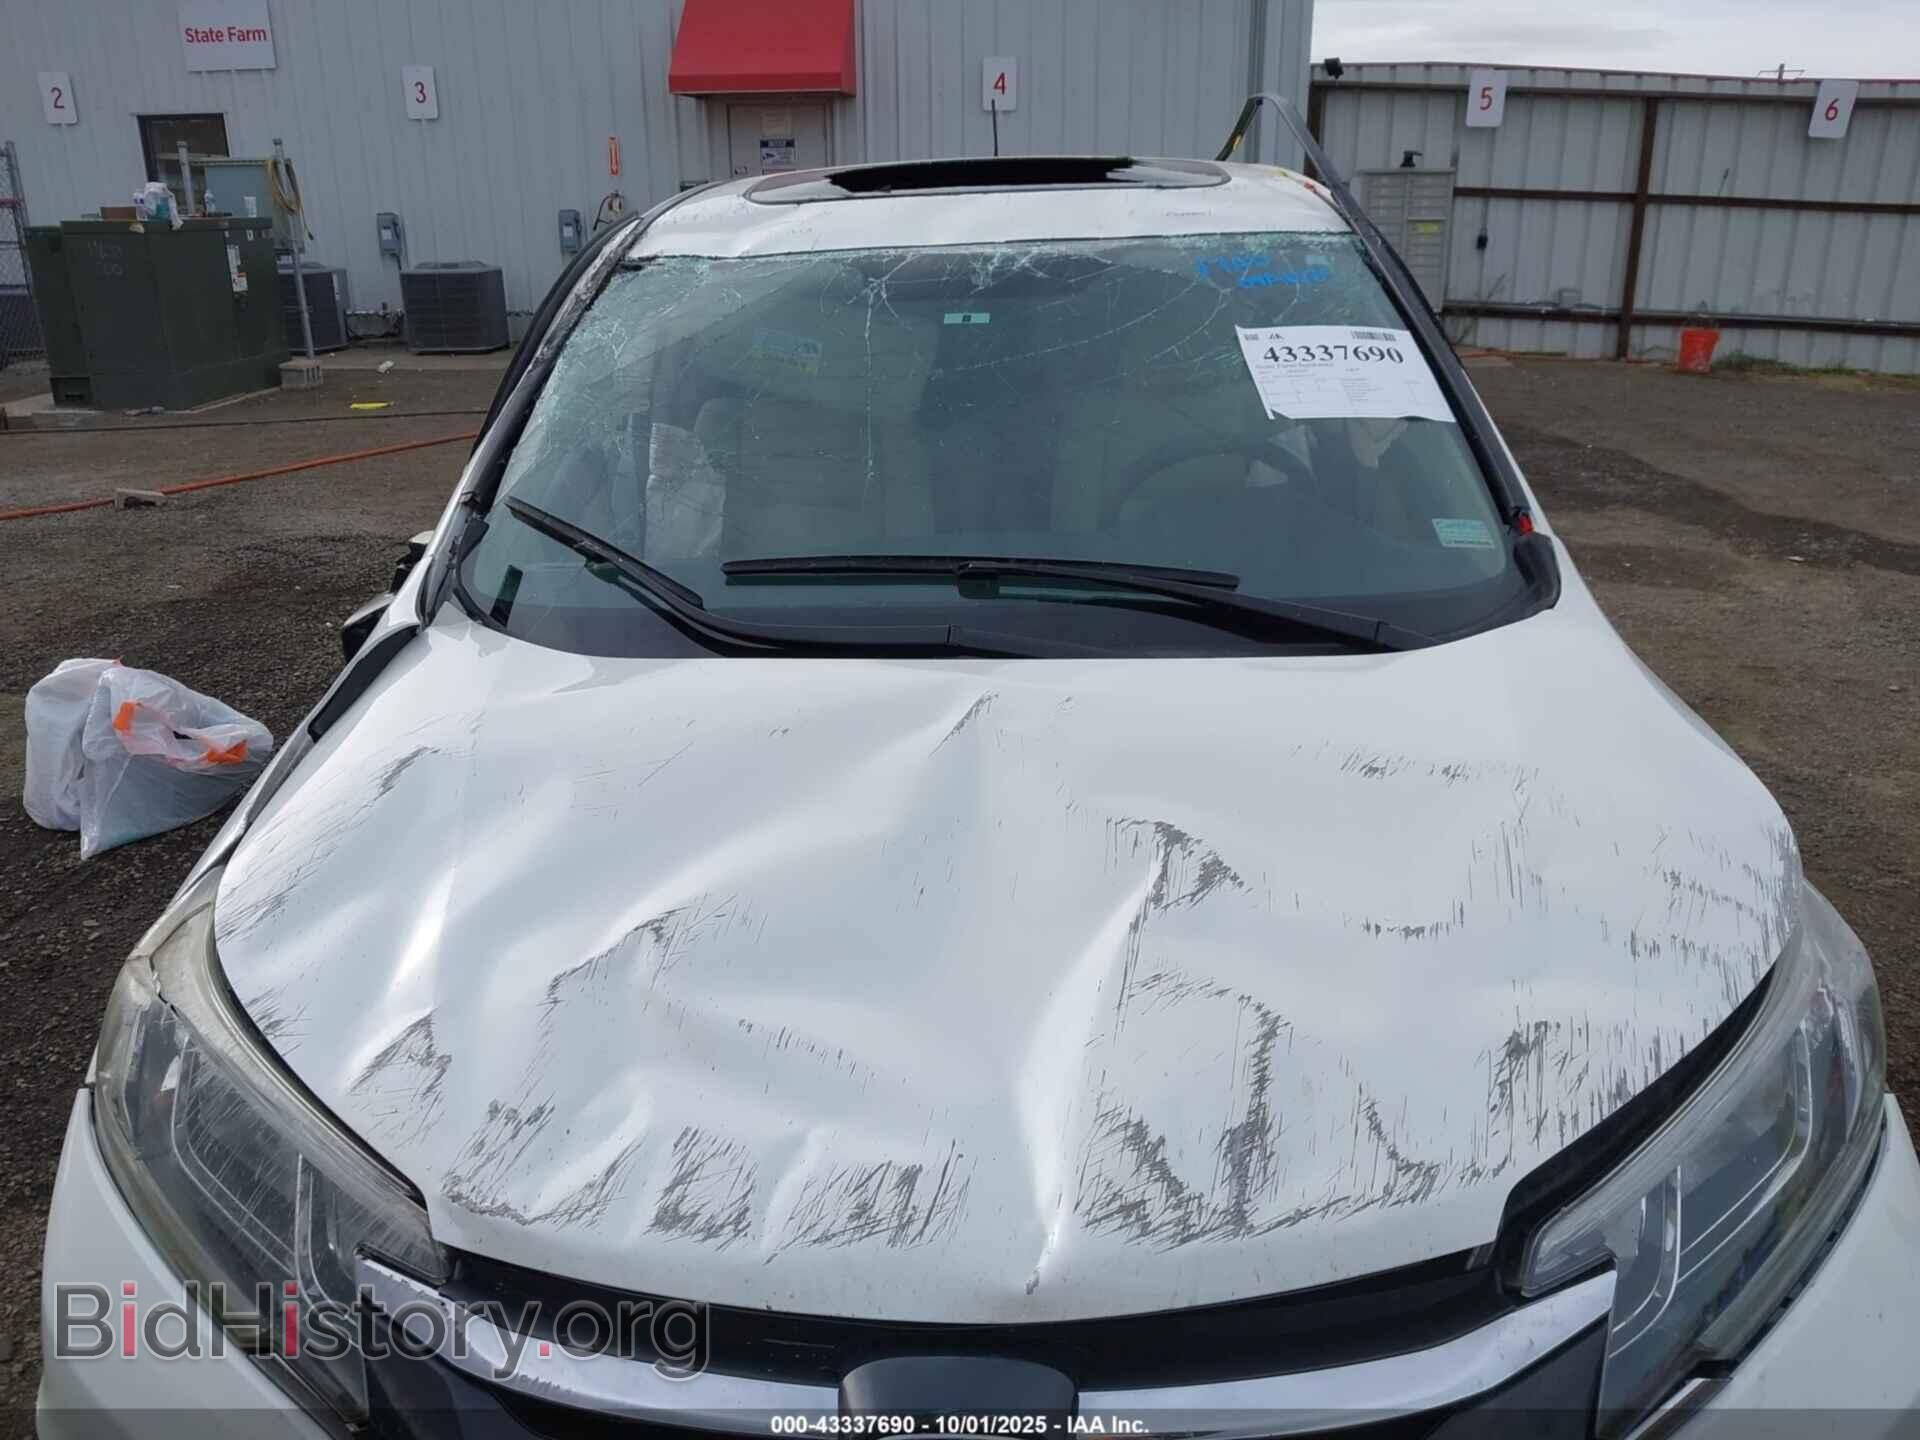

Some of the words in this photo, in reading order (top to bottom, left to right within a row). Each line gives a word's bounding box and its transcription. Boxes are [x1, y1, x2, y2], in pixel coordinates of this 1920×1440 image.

[185, 26, 225, 43] State
[227, 26, 267, 42] Farm
[415, 81, 427, 104] 3
[993, 72, 1007, 95] 4
[51, 86, 65, 109] 2
[1479, 87, 1493, 111] 5
[1824, 98, 1839, 122] 6
[1263, 344, 1404, 364] 43337690
